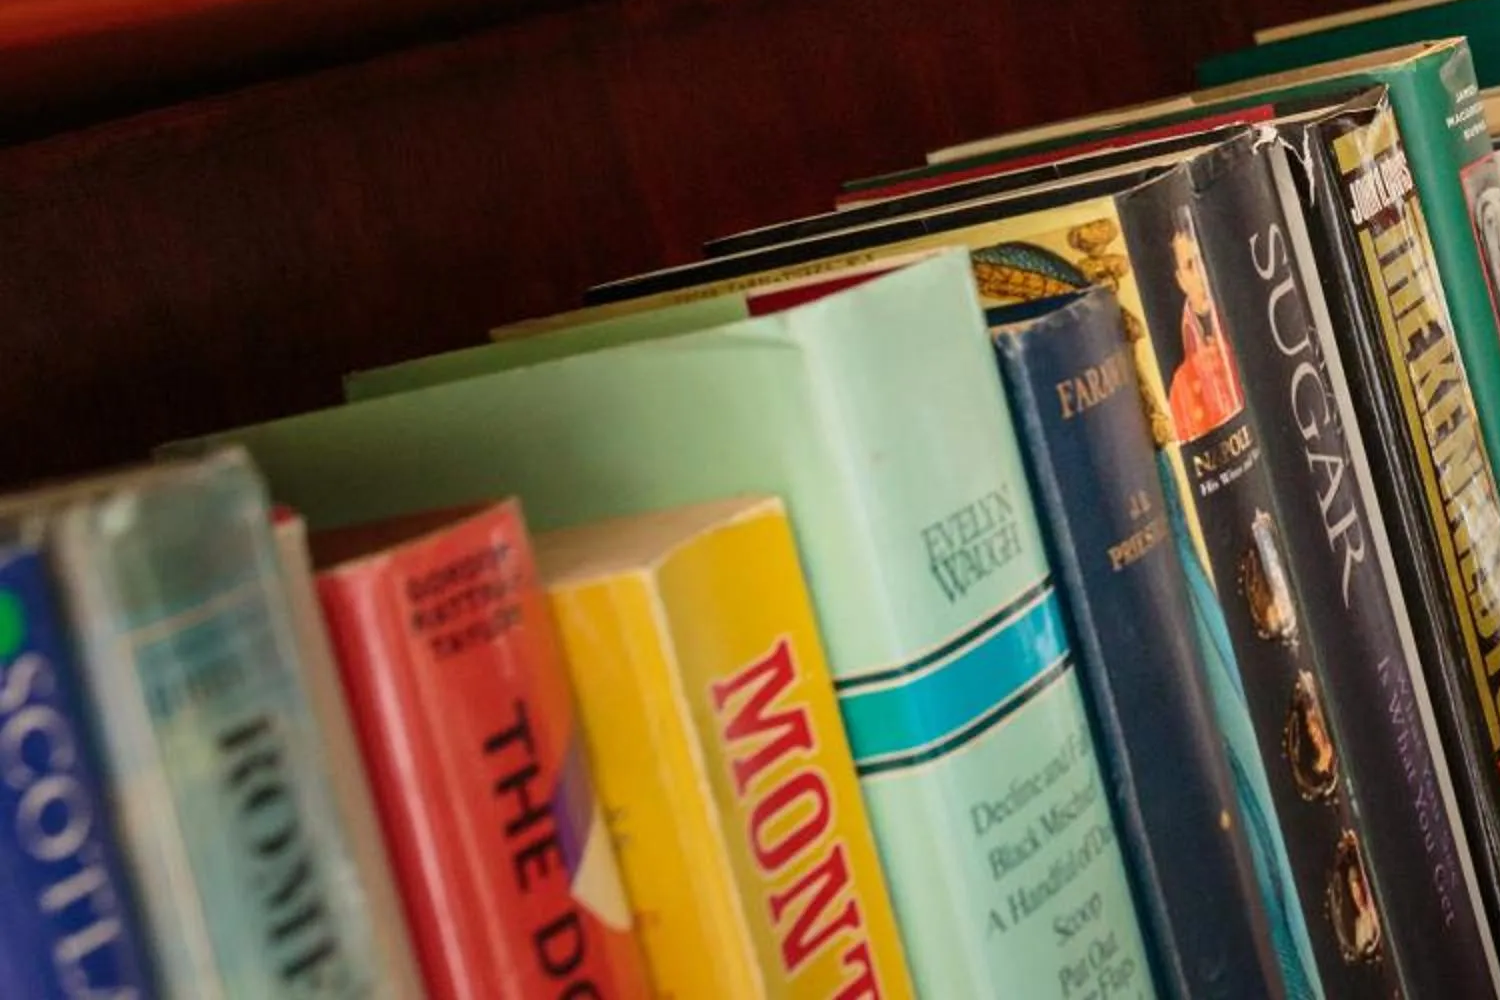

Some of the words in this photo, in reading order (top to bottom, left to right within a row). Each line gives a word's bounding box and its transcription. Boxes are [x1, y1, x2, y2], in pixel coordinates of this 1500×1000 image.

[920, 482, 1016, 556] EVELYN
[1247, 219, 1368, 610] SUGAR
[927, 521, 1025, 604] WAUGH
[0, 652, 140, 1000] SCOTL
[482, 699, 564, 893] THE
[532, 912, 606, 1000] D
[1384, 696, 1421, 784] What
[1413, 786, 1438, 851] You
[1433, 862, 1457, 930] Get
